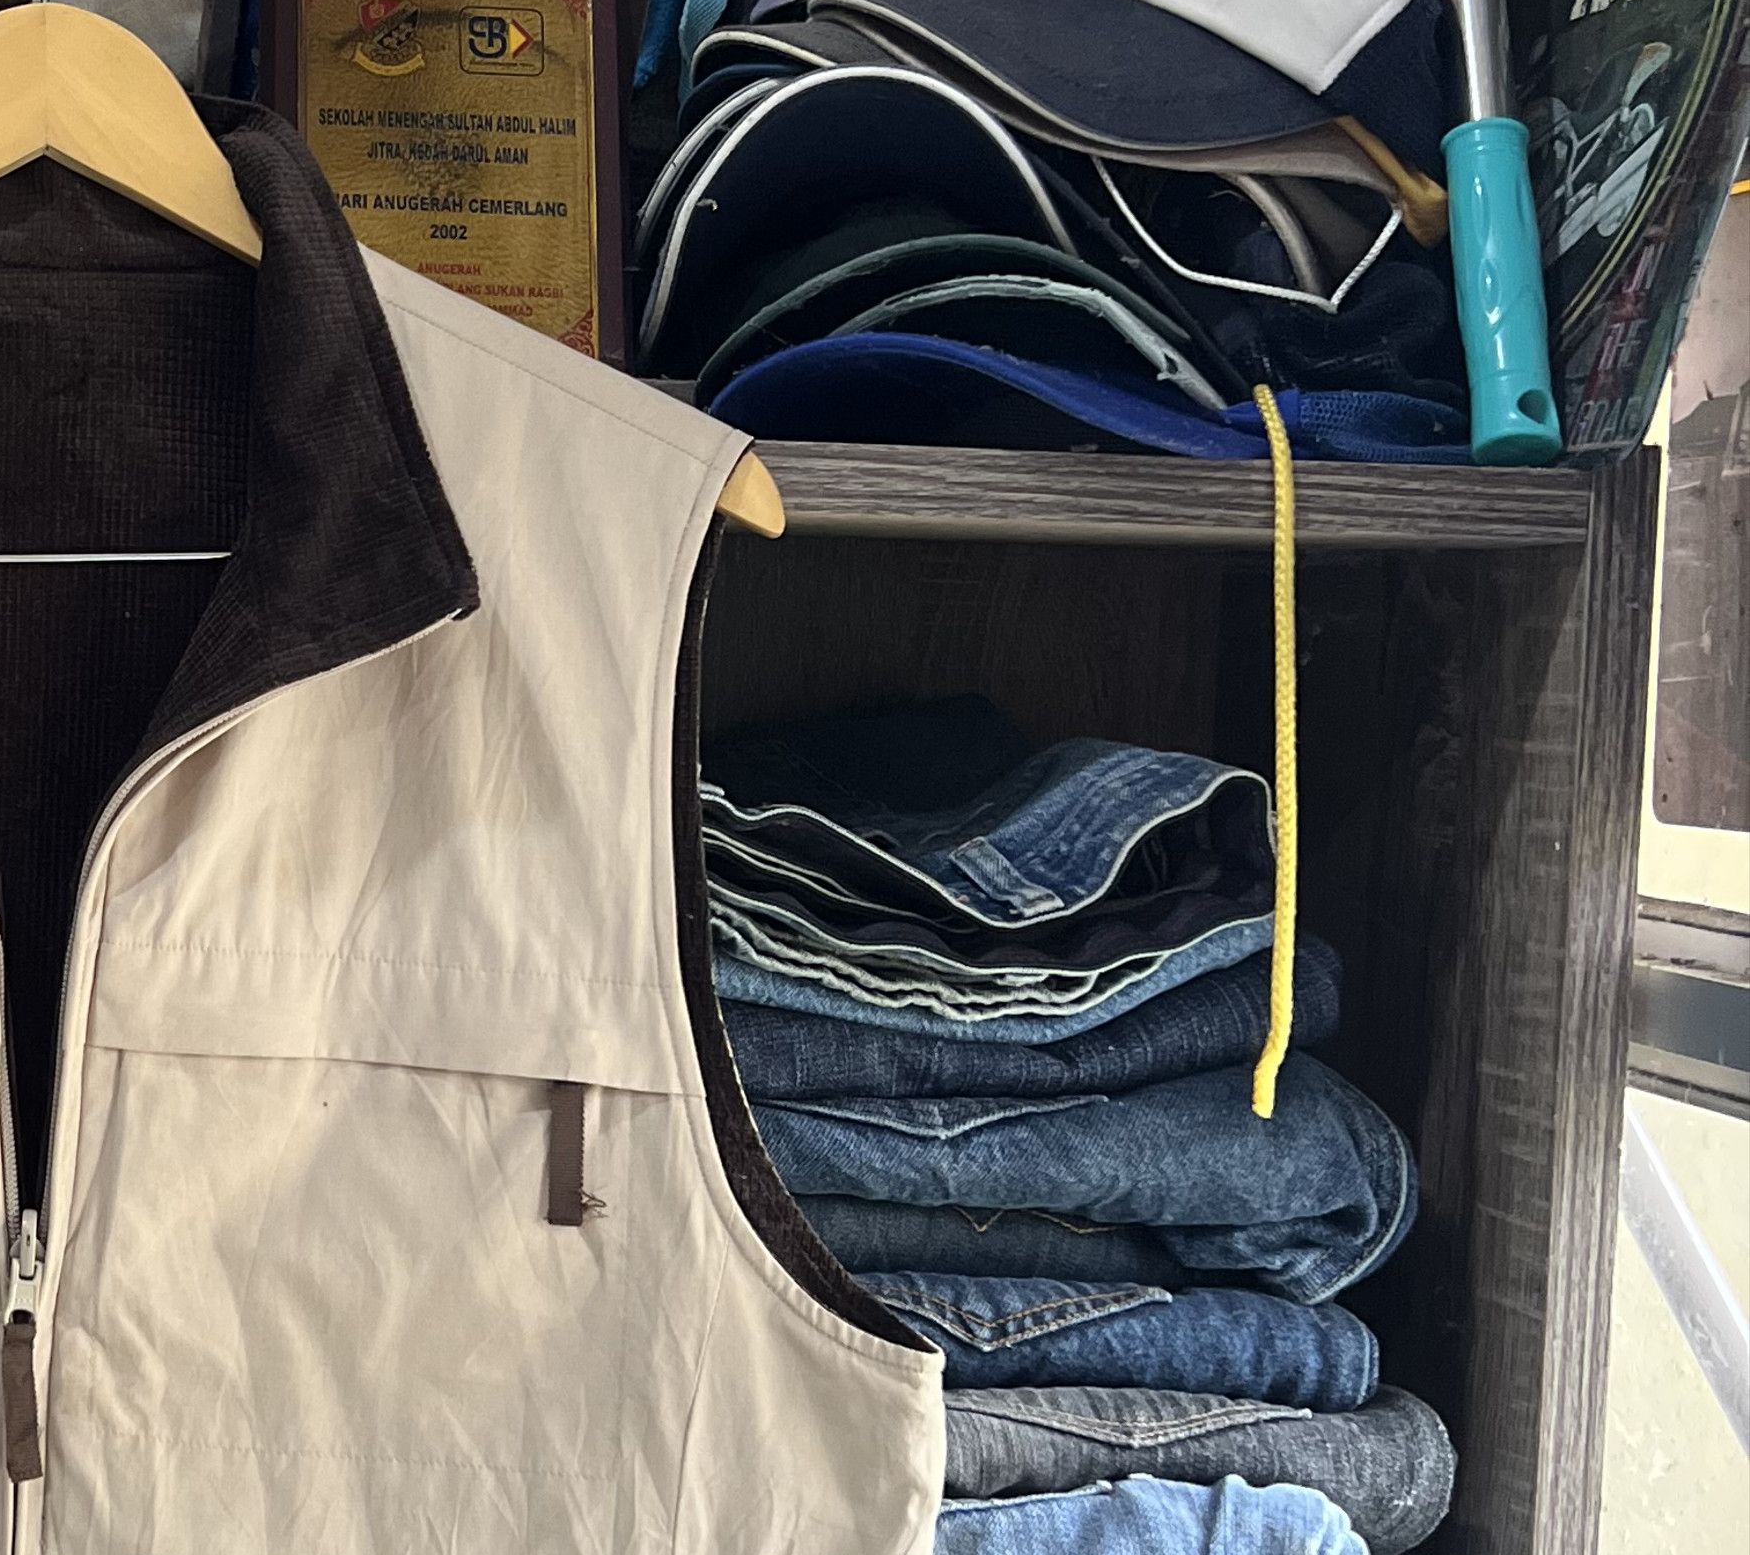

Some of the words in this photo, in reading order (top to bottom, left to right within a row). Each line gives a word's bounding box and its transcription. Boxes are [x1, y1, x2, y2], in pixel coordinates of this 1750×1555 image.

[319, 108, 374, 126] SEKOLAH
[378, 111, 444, 129] MENENGAH
[449, 113, 492, 131] SULTAN
[496, 116, 536, 134] ABDUL
[539, 118, 576, 136] HALIM
[452, 146, 490, 163] DARUL
[494, 148, 528, 164] AMAN
[373, 195, 463, 213] ANUGERAH
[468, 198, 567, 217] CEMERLANG
[430, 224, 467, 240] 2002
[417, 263, 481, 275] ANUGERAH
[485, 284, 524, 297] SUKAN
